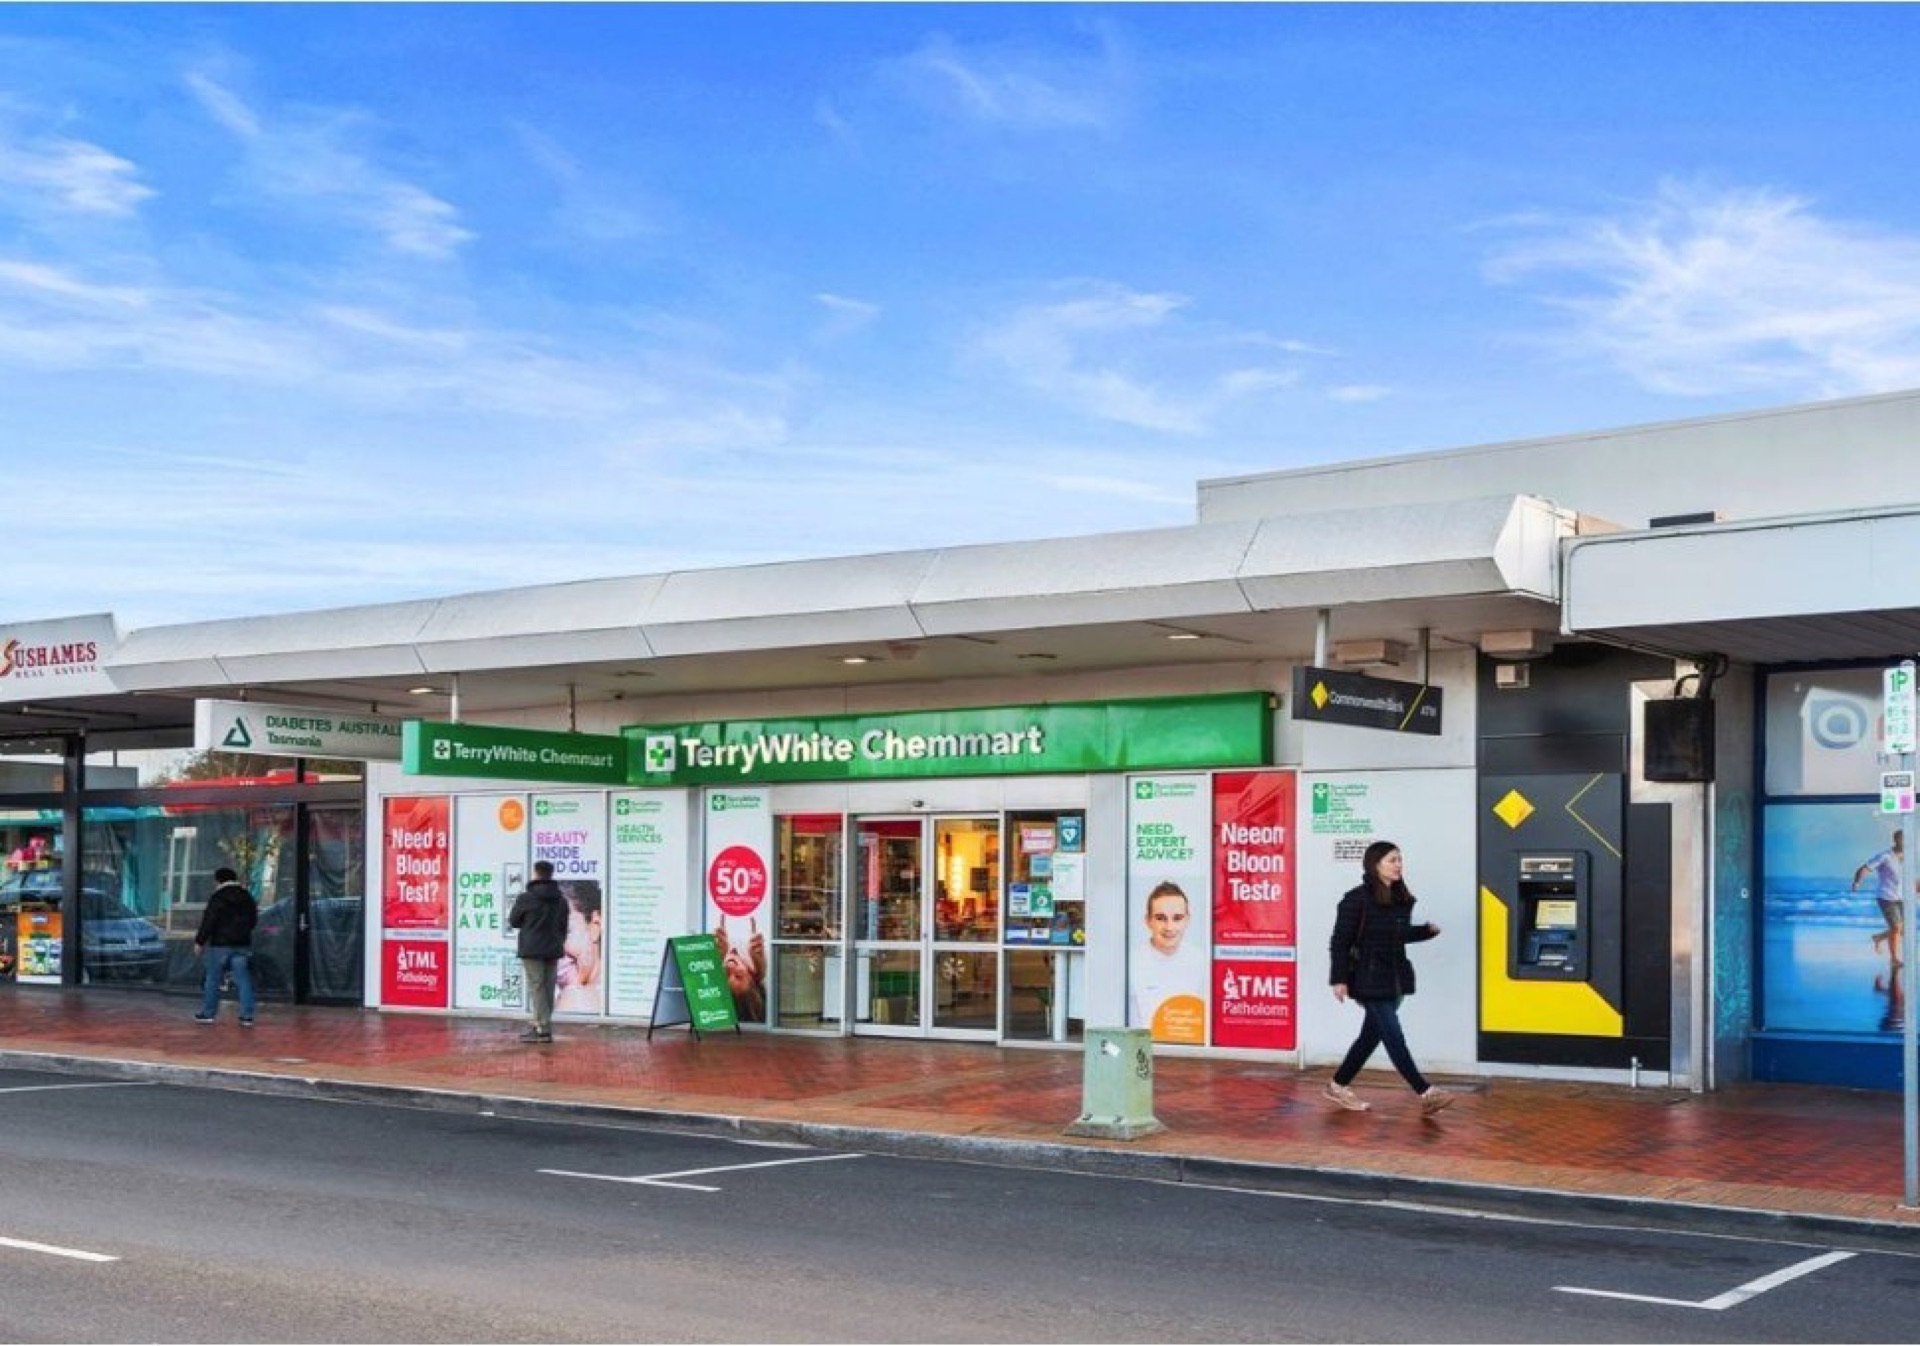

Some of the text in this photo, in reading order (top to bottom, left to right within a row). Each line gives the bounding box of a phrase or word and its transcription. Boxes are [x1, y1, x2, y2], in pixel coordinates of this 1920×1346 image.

[0, 639, 97, 677] SUSHAMES
[266, 715, 332, 732] DIABETES
[267, 731, 322, 747] Tasmania
[453, 742, 613, 768] TerryWhite Chemmart
[682, 725, 1045, 774] TerryWhite Chemmart
[616, 824, 655, 834] HEALTH
[1136, 824, 1174, 835] NEED
[392, 827, 447, 849] Need a
[536, 832, 588, 845] BEAUTY
[616, 834, 663, 844] SERVICES
[1136, 836, 1187, 847] EXPERT
[536, 846, 580, 860] INSIDE
[1136, 848, 1195, 860] ADVICE?
[396, 854, 442, 875] Blood
[570, 860, 598, 874] OUT
[396, 881, 440, 903] Test?
[459, 893, 470, 909] 7
[406, 951, 439, 969] TML
[688, 959, 715, 972] OPEN
[397, 970, 438, 986] Pathology
[697, 987, 721, 999] DAYS
